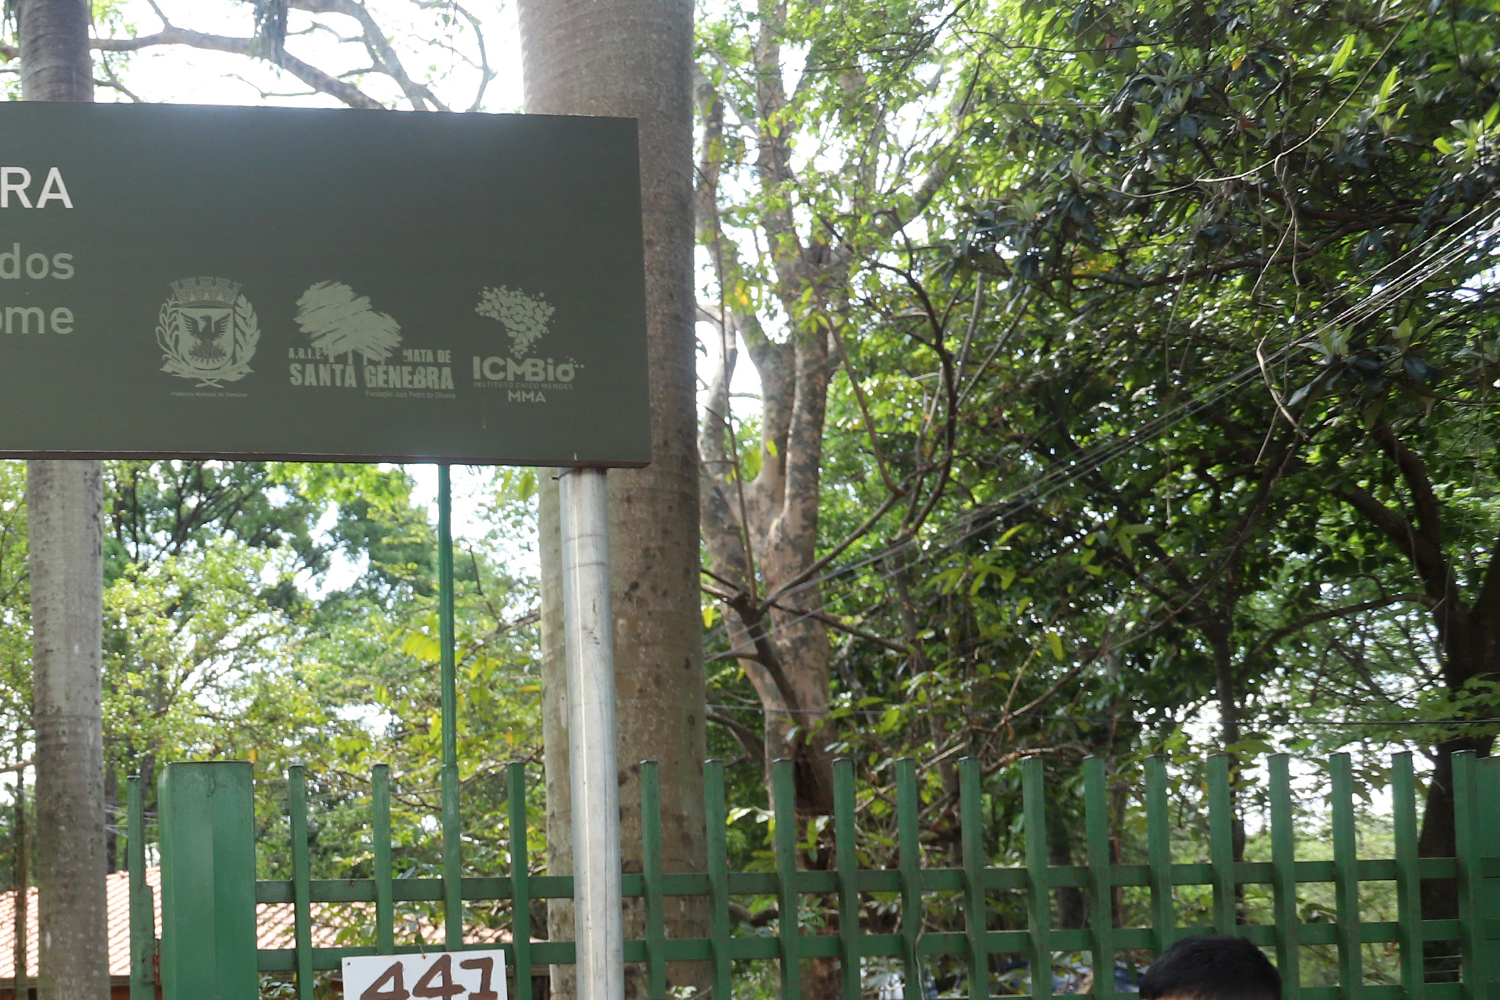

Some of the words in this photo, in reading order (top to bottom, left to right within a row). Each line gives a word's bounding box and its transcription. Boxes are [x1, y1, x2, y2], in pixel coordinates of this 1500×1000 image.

[437, 349, 452, 363] DE
[289, 362, 358, 388] SANTA
[364, 364, 455, 390] GENEBRA
[472, 355, 576, 383] ICMBio
[473, 381, 514, 389] INSTITUTO
[507, 389, 547, 403] MMA
